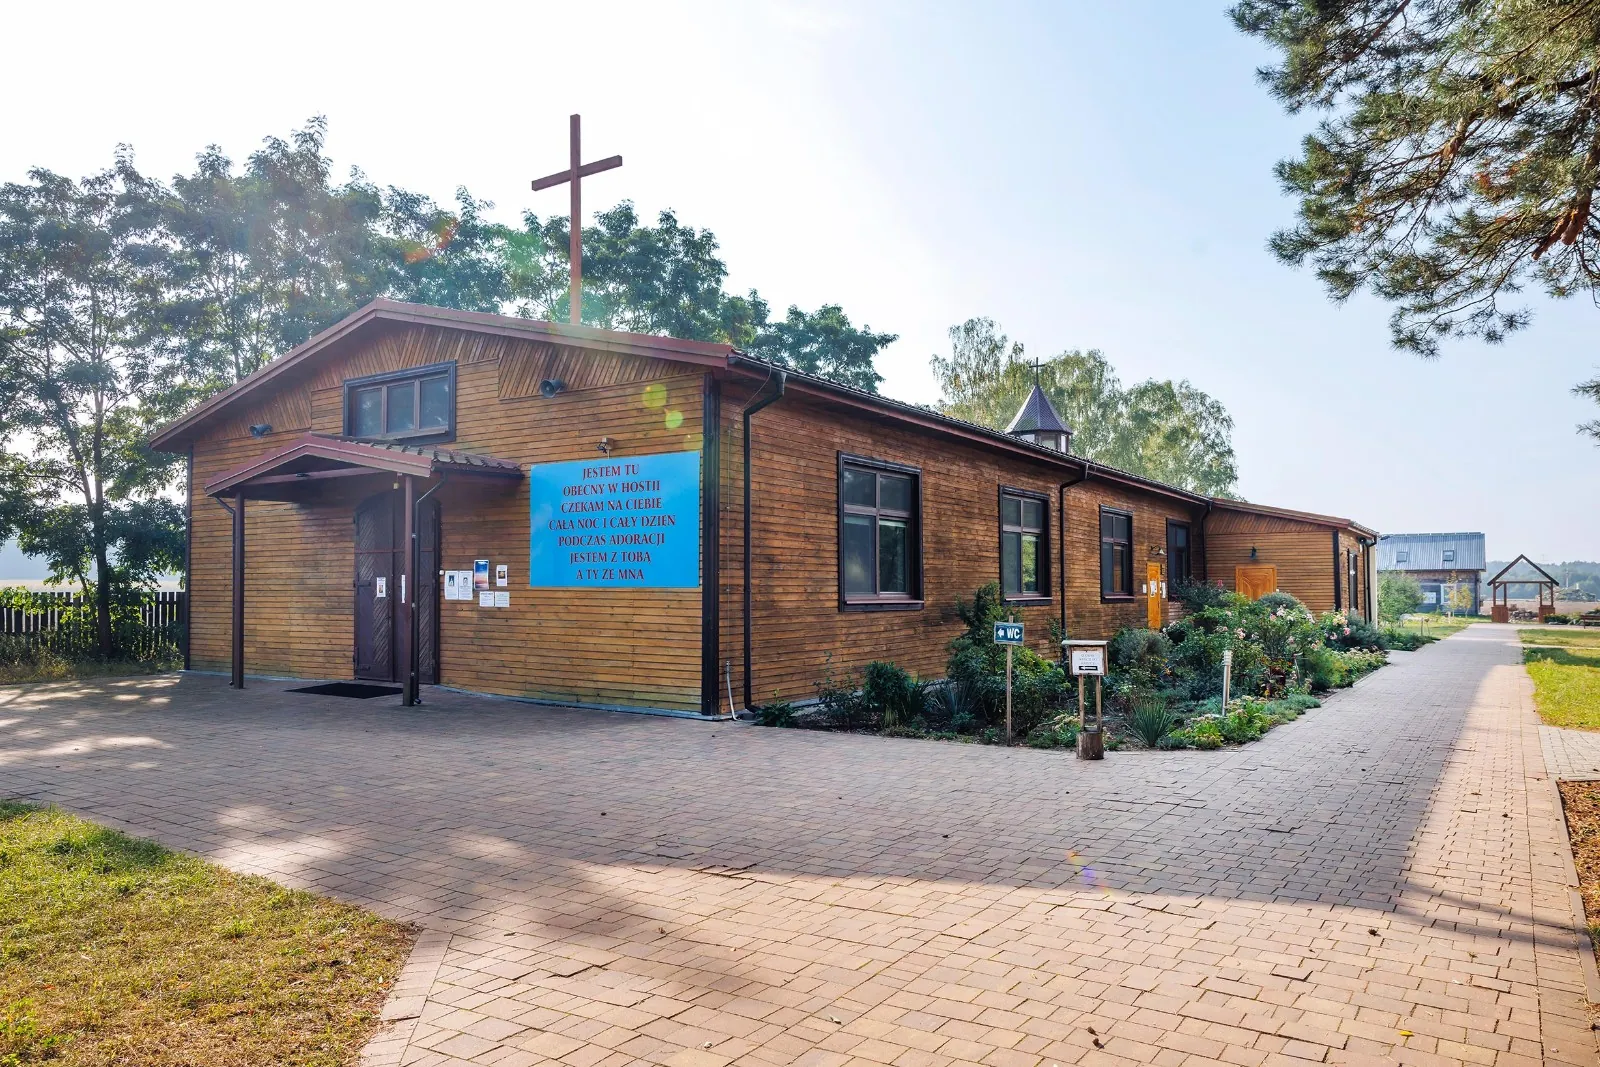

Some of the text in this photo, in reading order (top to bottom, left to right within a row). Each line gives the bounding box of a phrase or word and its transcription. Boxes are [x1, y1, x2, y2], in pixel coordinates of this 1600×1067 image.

[583, 464, 639, 480] JESTEM TU
[563, 481, 660, 496] OBECNY W HOSTII
[561, 498, 661, 513] CZEKAM NA CIEBIE
[549, 519, 574, 531] CAŁĄ
[577, 518, 599, 529] NOC
[603, 517, 606, 528] I
[610, 517, 638, 528] CAŁY
[558, 533, 665, 547] PODCZAS ADORACJI
[570, 552, 651, 564] JESTEM Z TOBĄ
[576, 569, 583, 580] A
[586, 569, 598, 579] TY
[602, 569, 614, 579] ZE
[1007, 628, 1020, 639] WC
